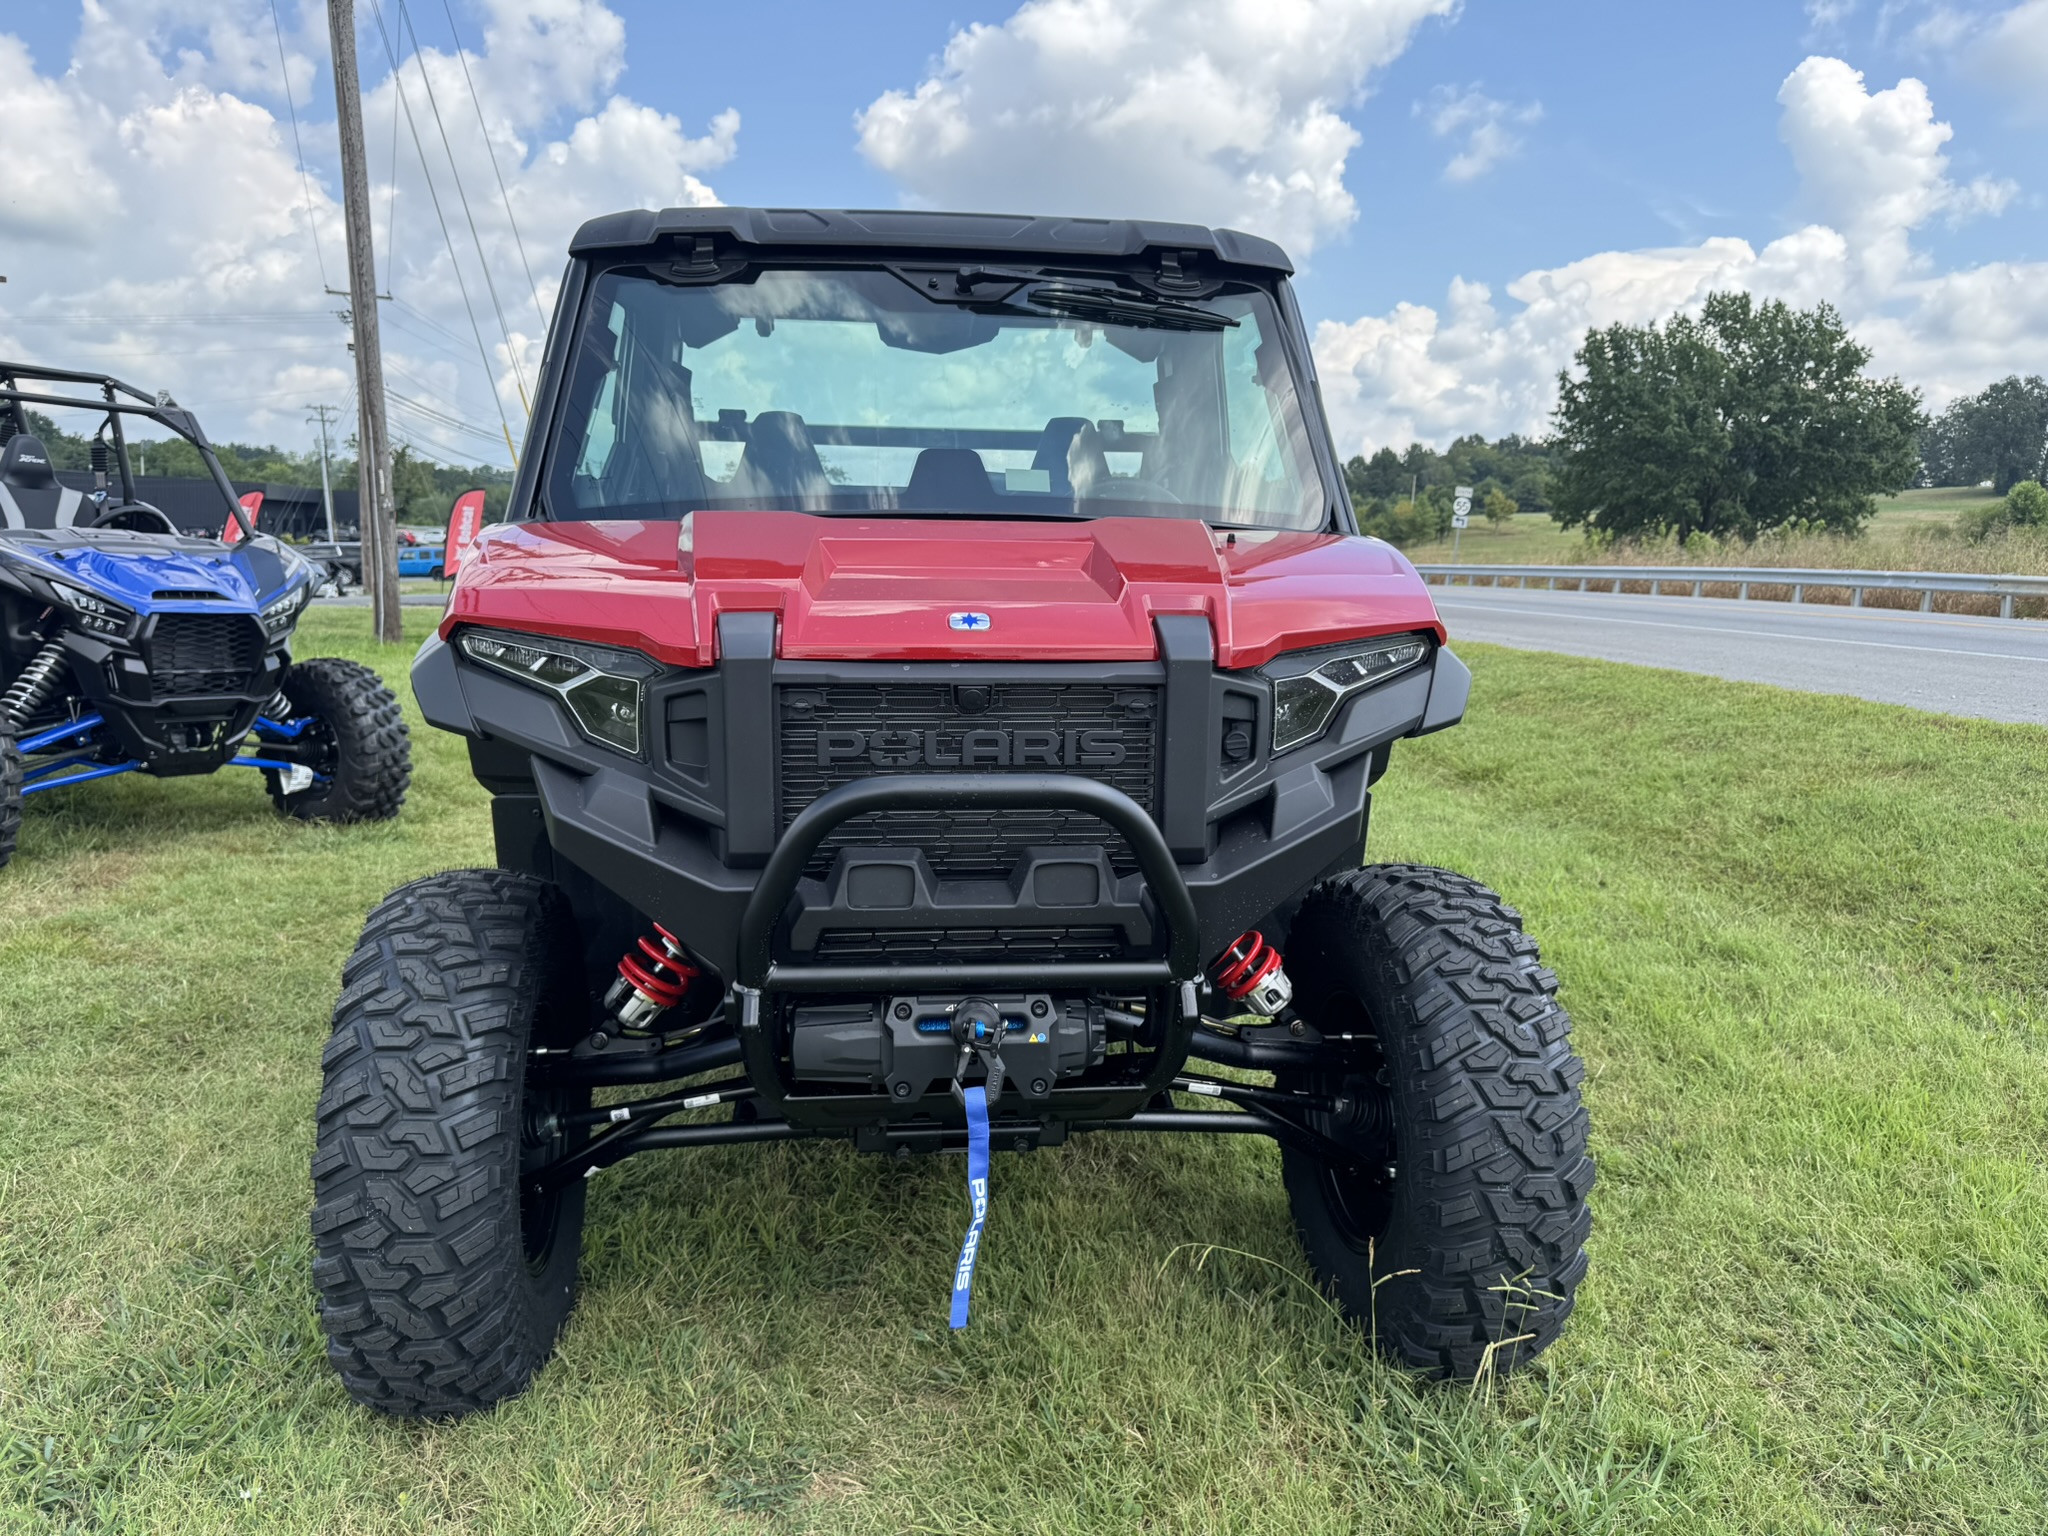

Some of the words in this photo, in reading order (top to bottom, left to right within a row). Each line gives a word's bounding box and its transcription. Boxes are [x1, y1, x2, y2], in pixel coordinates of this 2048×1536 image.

[1456, 501, 1469, 512] 55
[816, 730, 1127, 767] POLARIS
[956, 1178, 986, 1291] POLARIS
